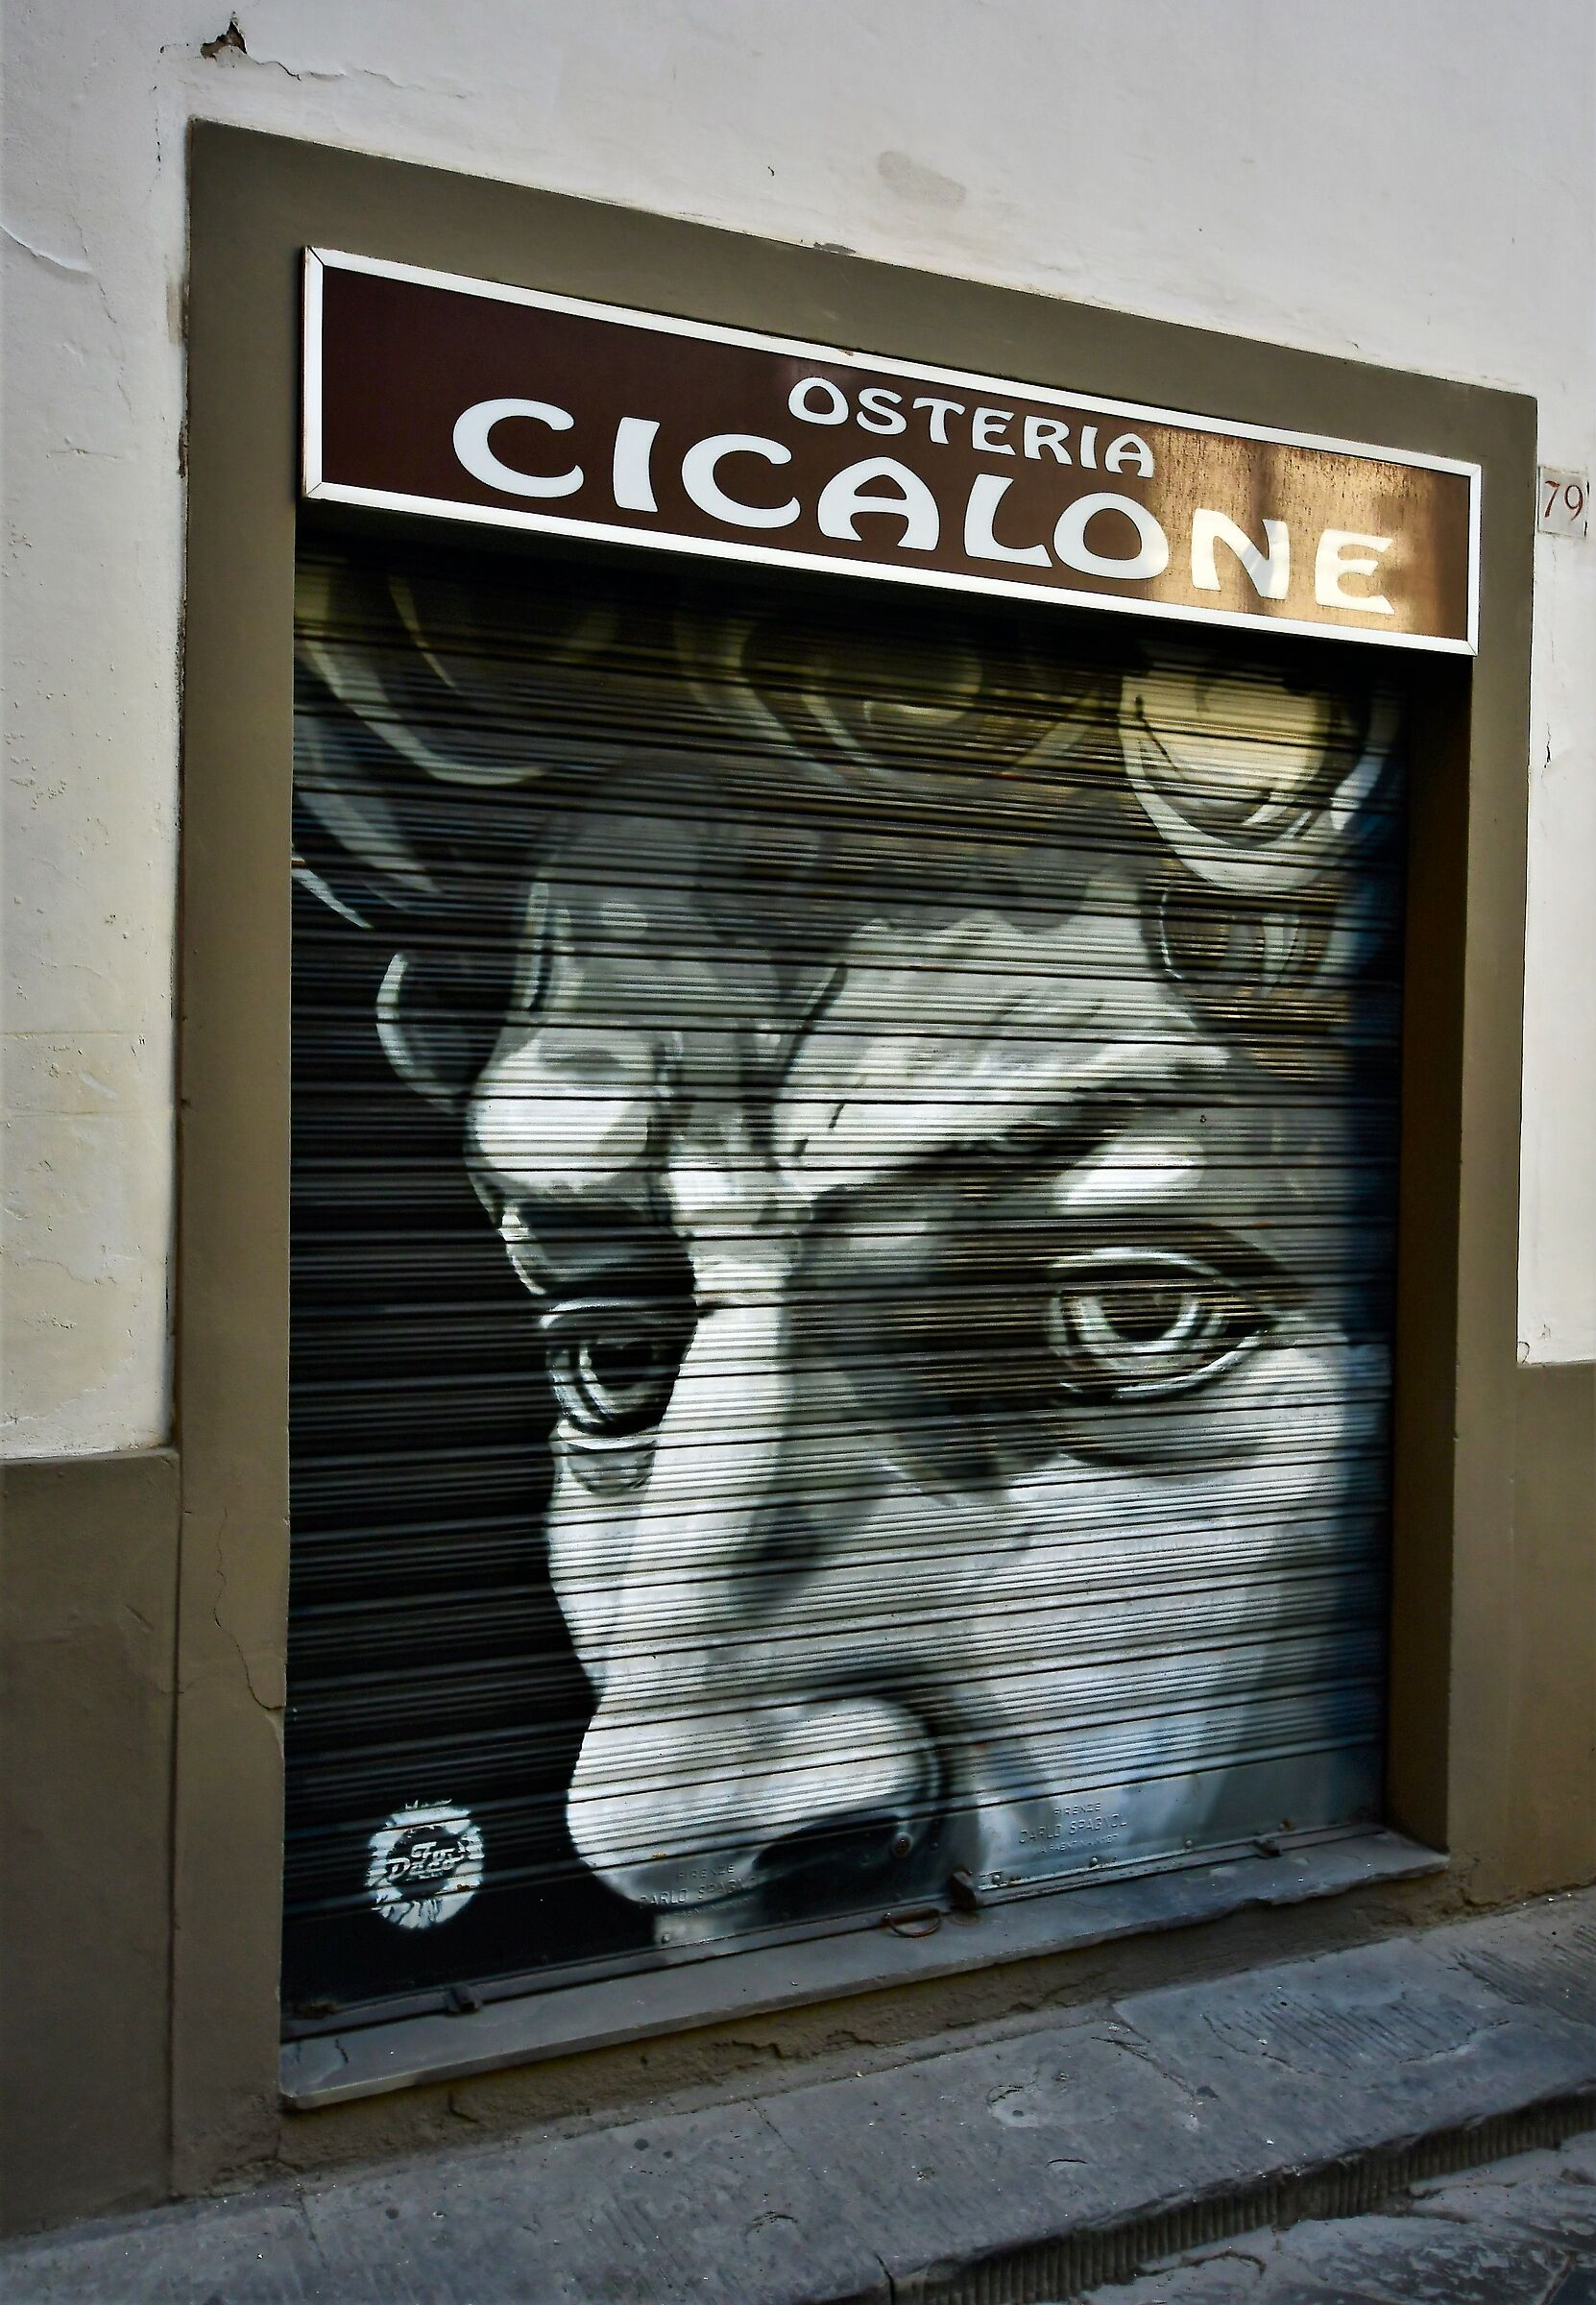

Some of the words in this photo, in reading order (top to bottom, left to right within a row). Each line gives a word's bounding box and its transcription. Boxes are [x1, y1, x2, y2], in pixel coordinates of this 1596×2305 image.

[788, 376, 1155, 479] OSTERIA
[453, 397, 1394, 616] CICALONE
[1544, 480, 1584, 522] 79
[1052, 1802, 1101, 1816] FIRENZE
